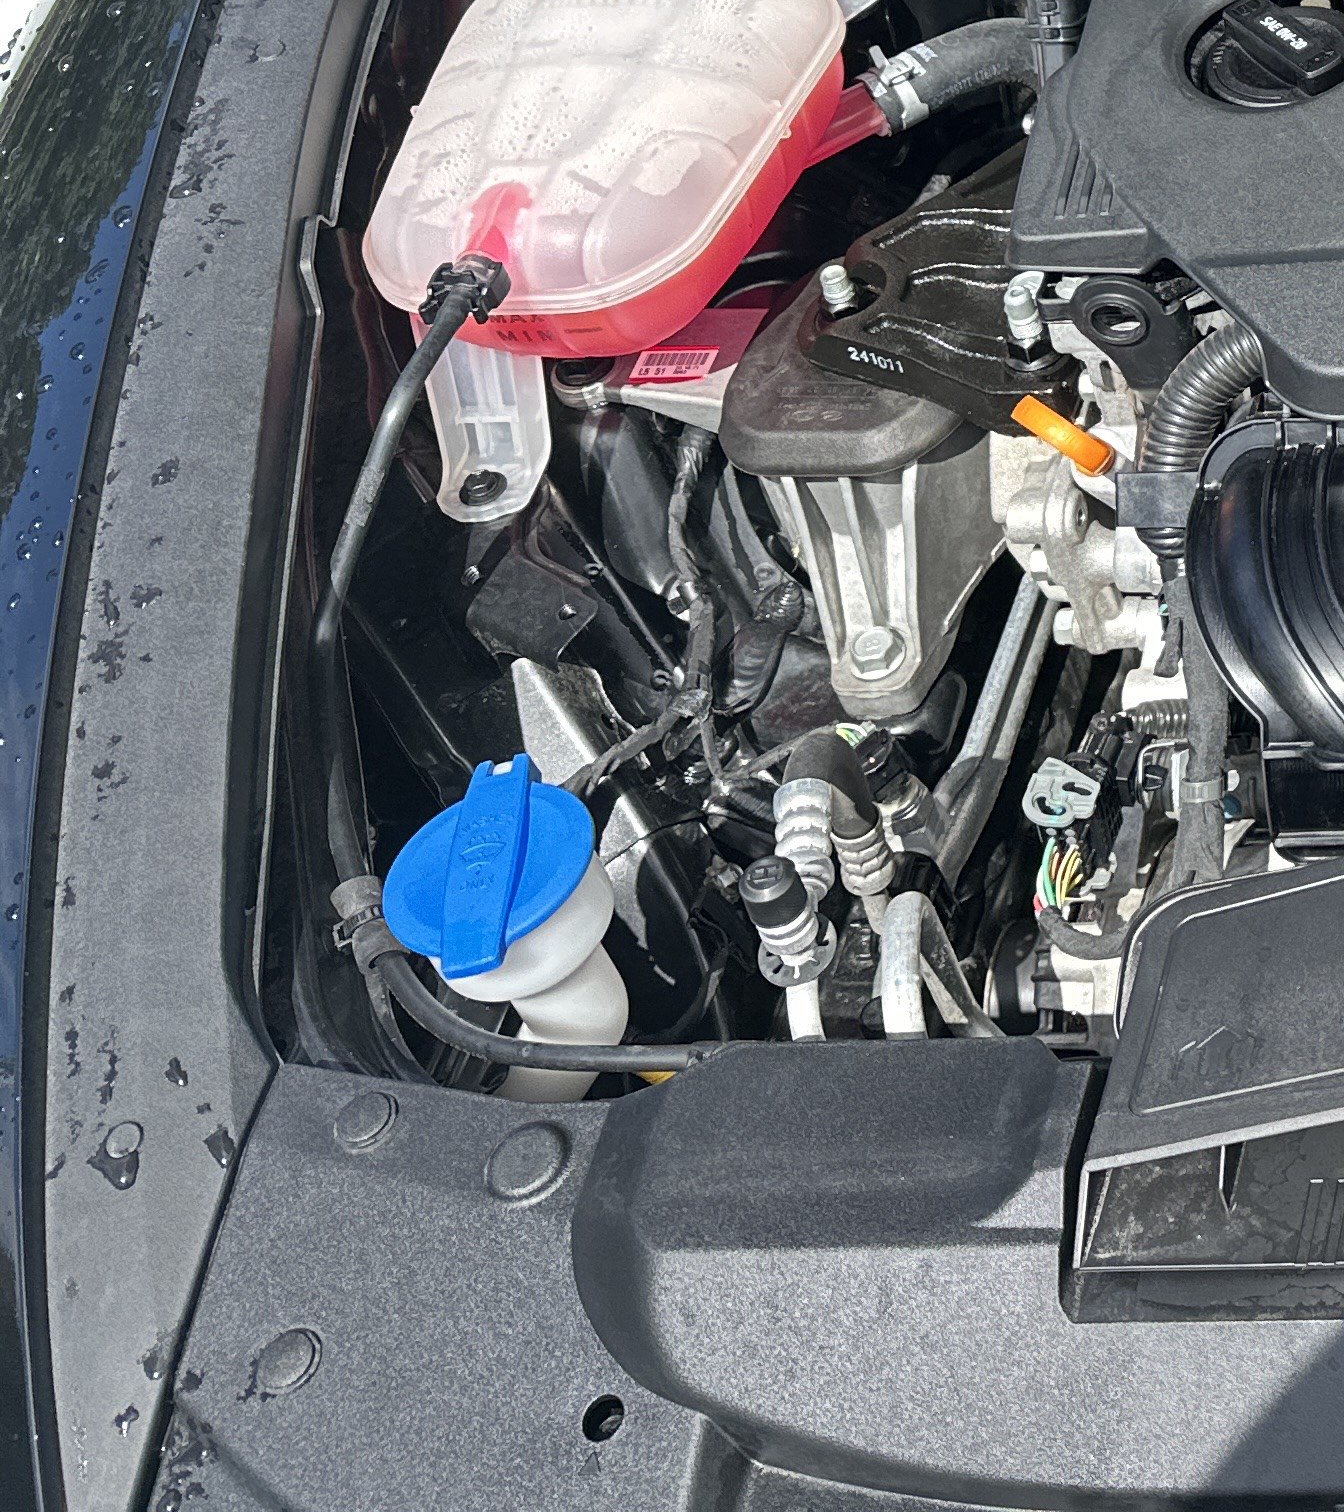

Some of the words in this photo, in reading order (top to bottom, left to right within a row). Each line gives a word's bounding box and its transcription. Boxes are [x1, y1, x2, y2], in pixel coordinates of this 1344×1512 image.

[1260, 16, 1284, 32] SAE
[496, 330, 554, 343] MIN
[847, 346, 904, 374] 241011
